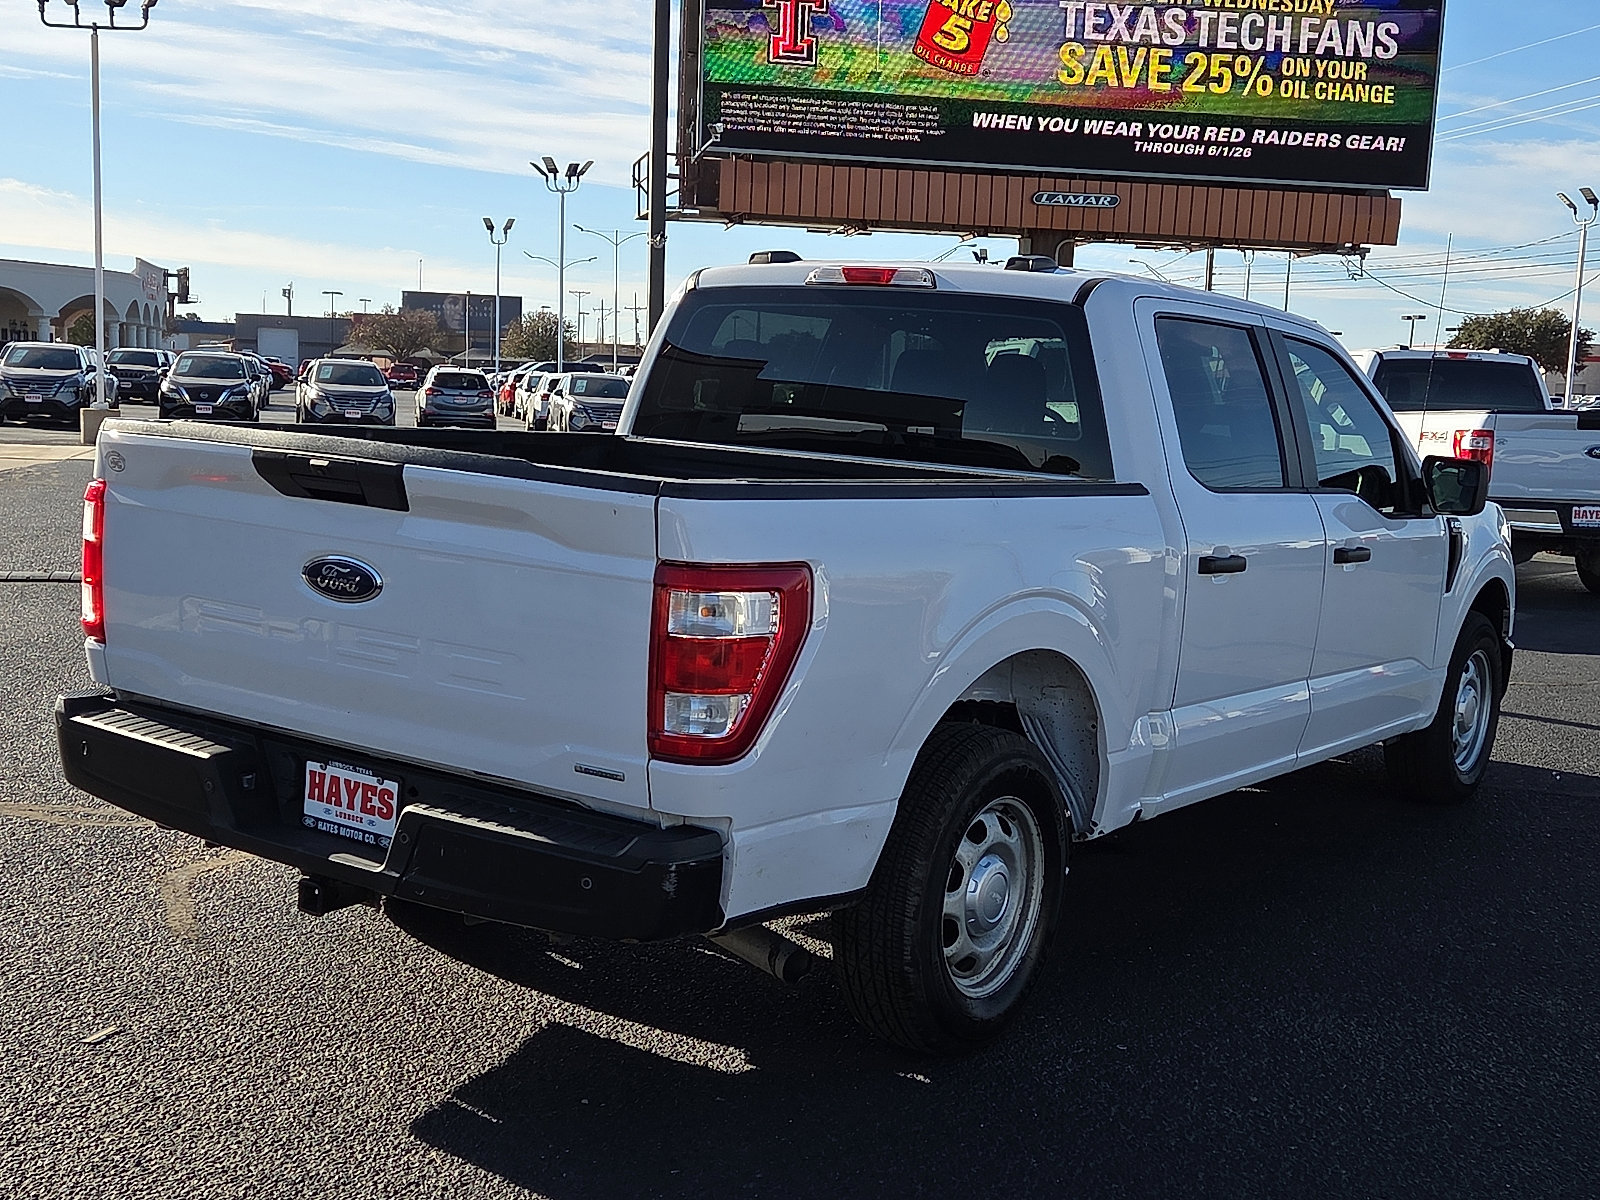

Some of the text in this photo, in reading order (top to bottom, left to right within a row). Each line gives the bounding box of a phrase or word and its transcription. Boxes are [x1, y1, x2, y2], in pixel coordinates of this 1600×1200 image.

[937, 0, 995, 21] AKE
[932, 14, 972, 51] 5
[1058, 0, 1400, 59] TEXAS TECH FANS
[917, 45, 930, 59] OIL
[1057, 42, 1274, 97] SAVE 25%
[1281, 57, 1368, 81] ON YOUR
[1279, 79, 1395, 104] OIL CHANGE
[972, 112, 1406, 152] WHEN YOU WEAR YOUR RED RAIDERS GEAR!
[1134, 141, 1252, 158] THROUGH 6/1/26
[1040, 193, 1111, 207] LAMAR
[1420, 431, 1448, 441] FX4
[317, 564, 361, 593] Ford
[308, 770, 394, 820] HAYES
[318, 821, 338, 834] HAYES
[340, 827, 363, 841] MOTOR
